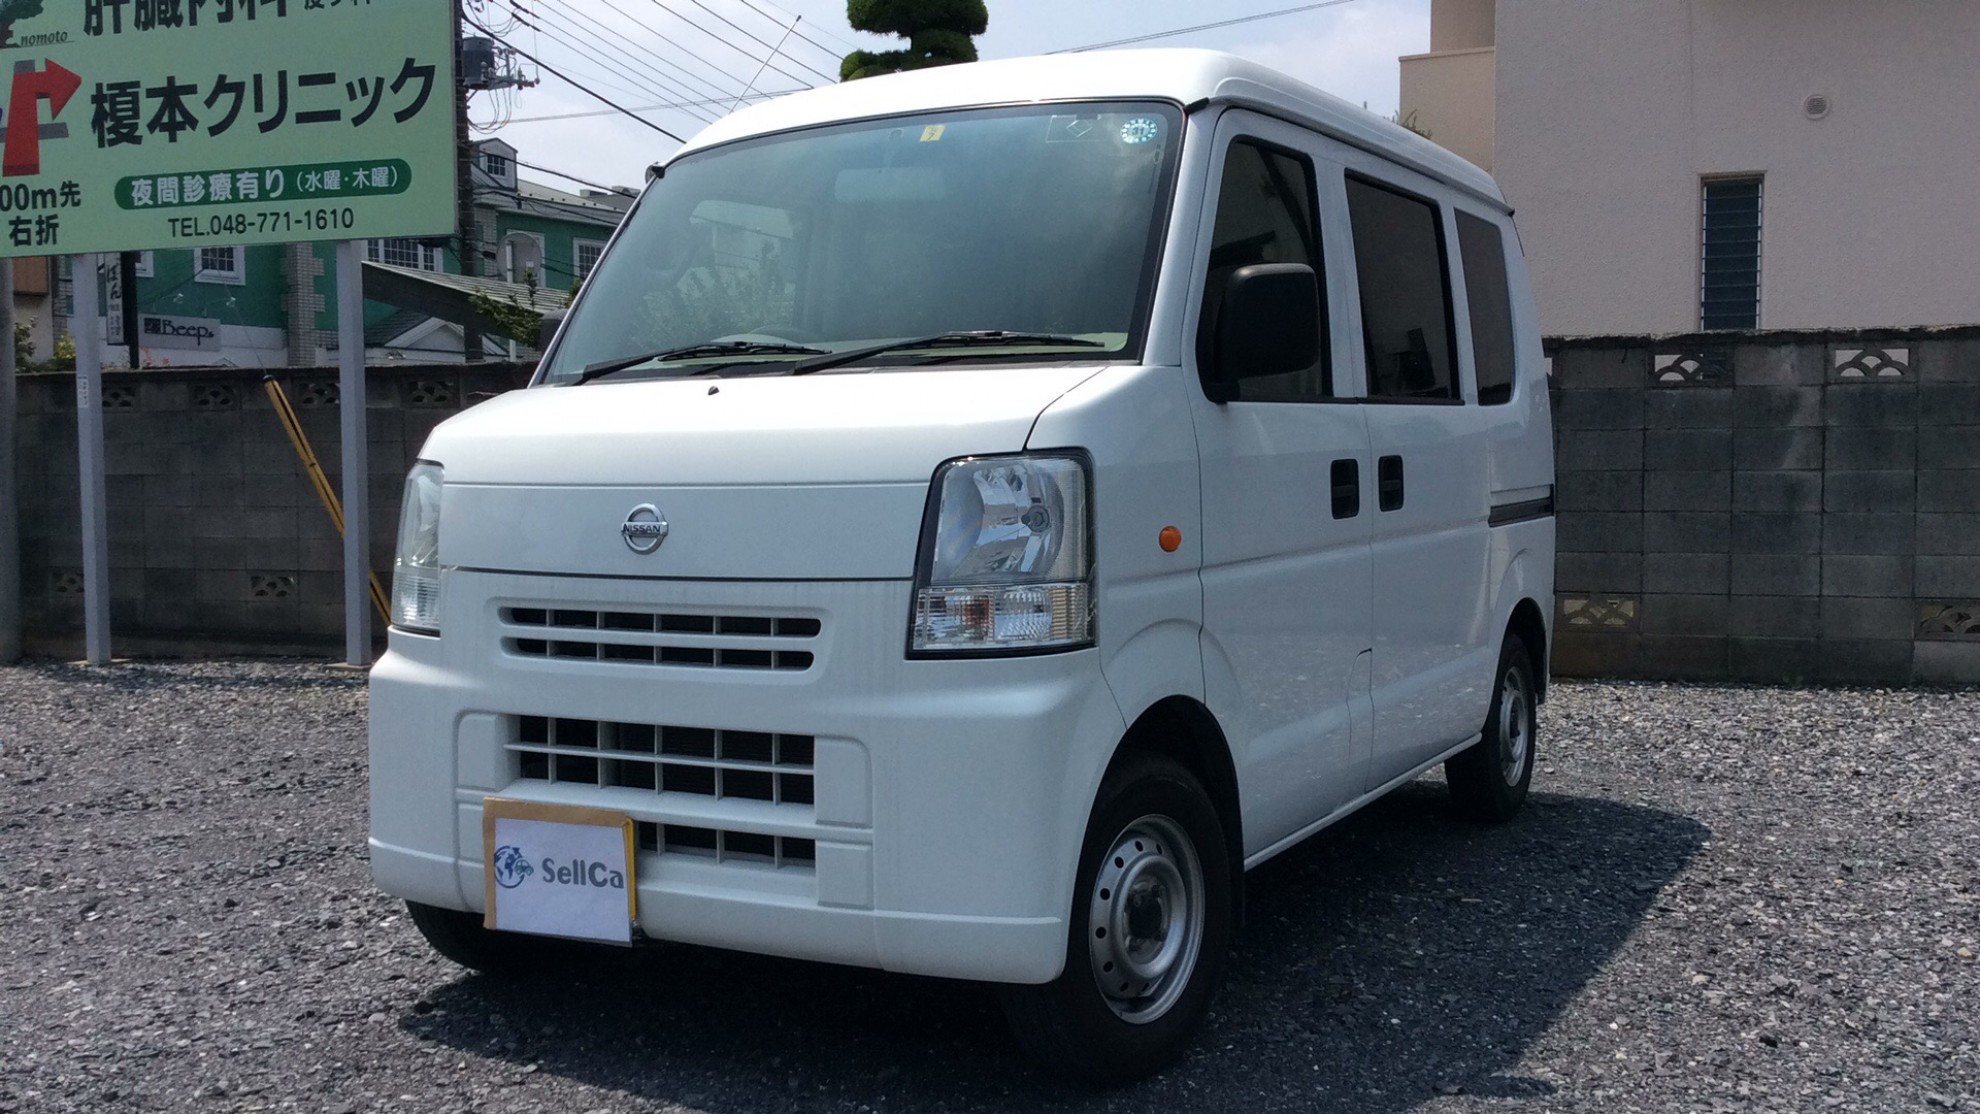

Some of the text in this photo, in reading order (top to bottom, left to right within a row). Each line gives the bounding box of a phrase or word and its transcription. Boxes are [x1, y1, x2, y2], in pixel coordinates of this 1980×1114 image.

[20, 30, 68, 47] nomoto
[91, 57, 436, 148] 榎本クリニック
[131, 169, 285, 206] 夜間診療有り
[8, 214, 60, 247] 右折
[168, 207, 354, 238] TEL.048-771-1610
[621, 523, 661, 533] NISSAN
[542, 857, 624, 889] SellCa
